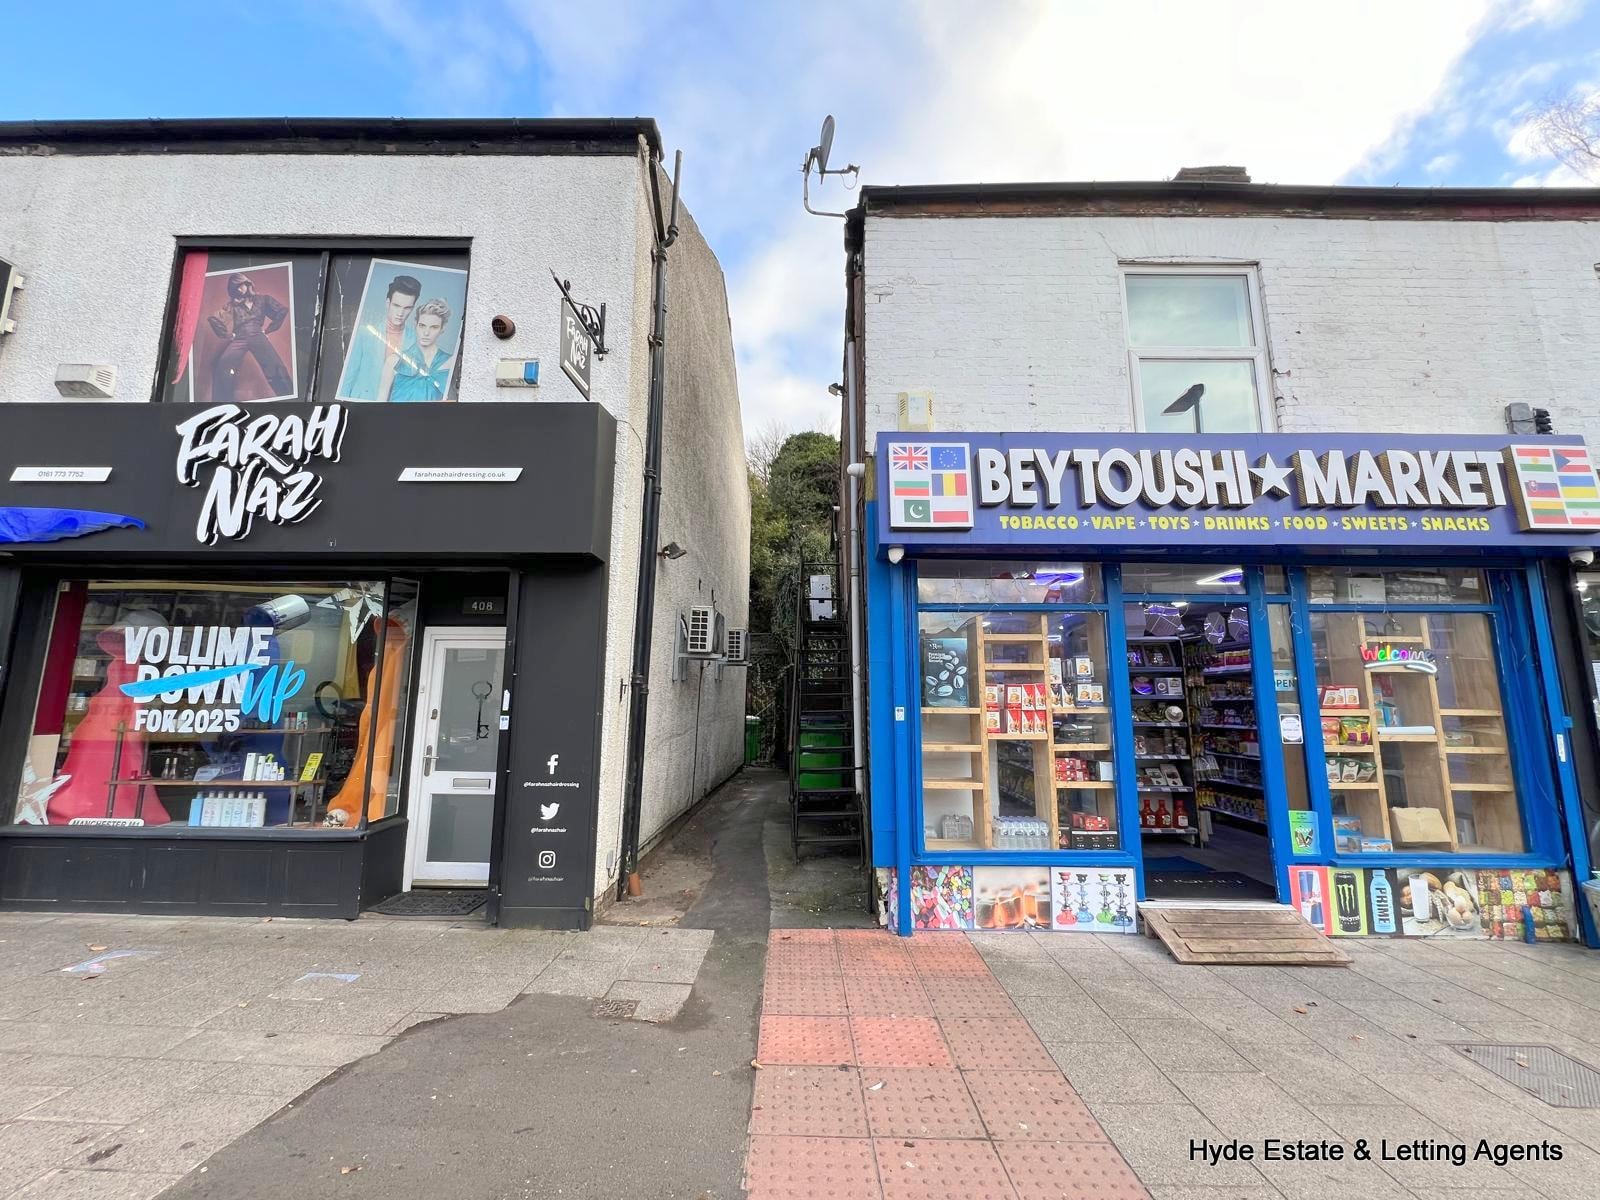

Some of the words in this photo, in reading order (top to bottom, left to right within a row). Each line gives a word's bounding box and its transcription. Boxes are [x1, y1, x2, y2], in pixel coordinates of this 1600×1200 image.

[566, 316, 588, 356] FARAH
[570, 340, 586, 370] NAZ
[176, 404, 347, 486] FARAH
[38, 470, 53, 478] 0161
[54, 470, 66, 478] 773
[68, 470, 84, 478] 7752
[414, 471, 506, 479] farahnazhairdressing.co.uk
[979, 448, 1254, 507] BEYTOUSHI
[1299, 449, 1507, 507] MARKET
[197, 459, 322, 545] NAZ
[1000, 516, 1079, 530] TOBACCO
[1091, 516, 1136, 530] VAPE
[1148, 516, 1190, 530] TOYS
[1204, 516, 1270, 531] DRINKS
[1284, 516, 1328, 531] FOOD
[1342, 516, 1408, 531] SWEETS
[1421, 517, 1490, 531] SNACKS
[471, 601, 493, 611] 408
[125, 626, 274, 666] VOLUME
[1274, 679, 1295, 688] PEN
[135, 709, 176, 733] FOR
[178, 709, 241, 734] 2025
[1375, 887, 1391, 924] PRIME
